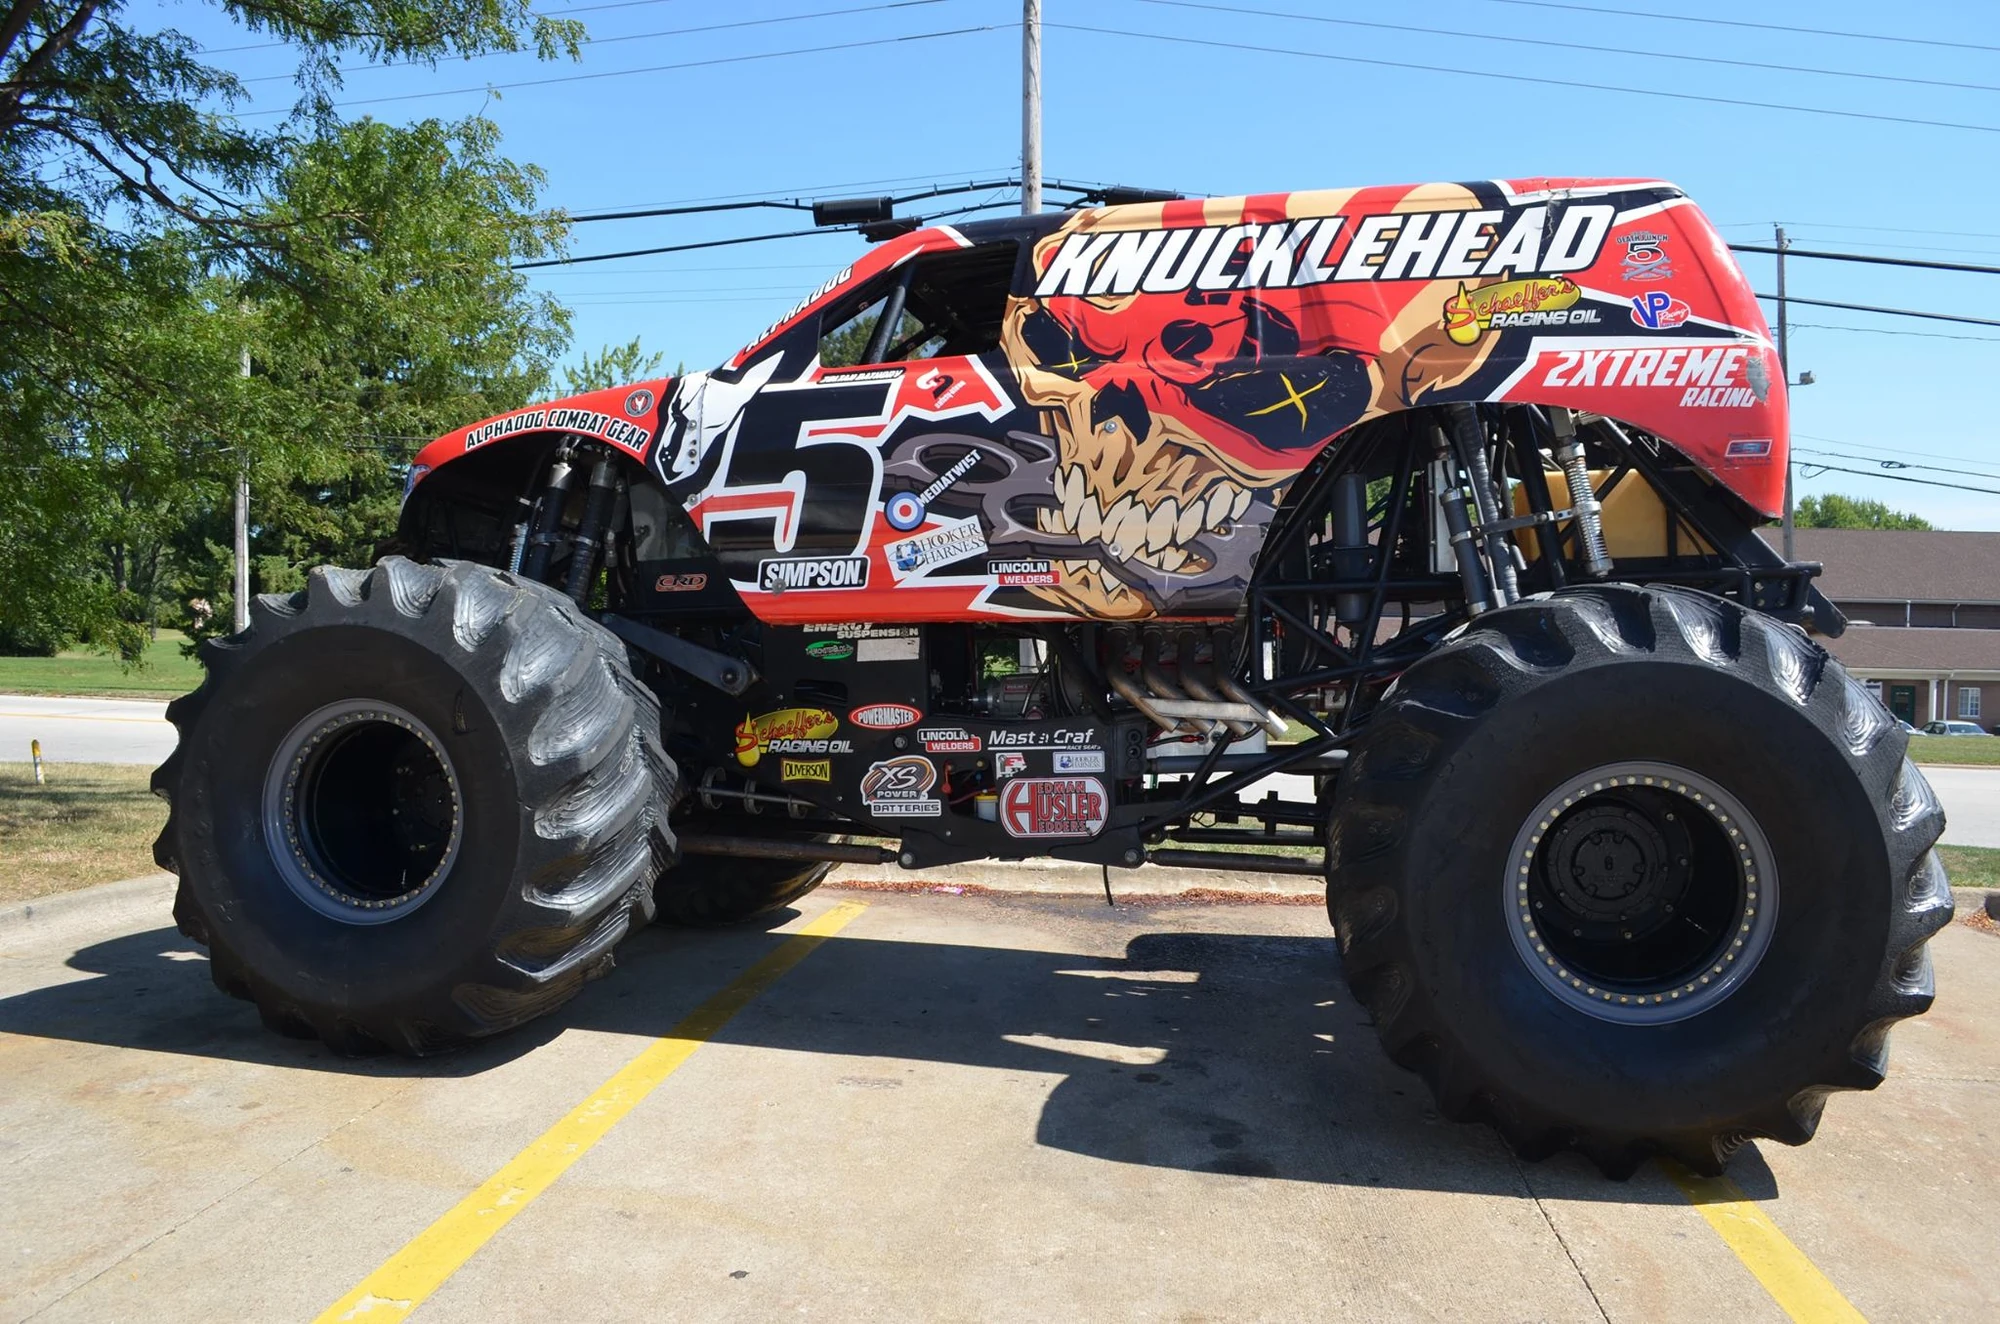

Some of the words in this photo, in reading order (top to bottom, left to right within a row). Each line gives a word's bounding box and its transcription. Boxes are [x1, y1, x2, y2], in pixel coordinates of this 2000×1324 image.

[1035, 205, 1617, 297] KNUCKLEHEAD
[1446, 277, 1575, 329] Schaeffer's
[1632, 292, 1670, 328] VP
[1490, 311, 1568, 328] RACING
[1569, 309, 1601, 324] OIL
[1542, 349, 1748, 387] 2XTREME
[1680, 388, 1756, 407] RACING
[466, 410, 545, 450] ALPHADOG
[547, 410, 609, 433] COMBAT
[605, 419, 650, 452] GEAR
[916, 449, 981, 507] MEDIATWIST
[920, 522, 980, 551] HOOKER
[925, 536, 986, 564] HARNESS
[765, 560, 861, 588] SIMPSON
[992, 562, 1048, 573] LINCOLN
[1004, 575, 1053, 584] WELDERS
[837, 628, 919, 639] SUSPENSIN
[858, 707, 914, 726] POWERMASTER
[768, 740, 827, 753] RACING
[828, 740, 853, 753] OIL
[921, 731, 968, 740] LINCOLN
[932, 742, 974, 750] WELDERS
[868, 766, 917, 795] XS
